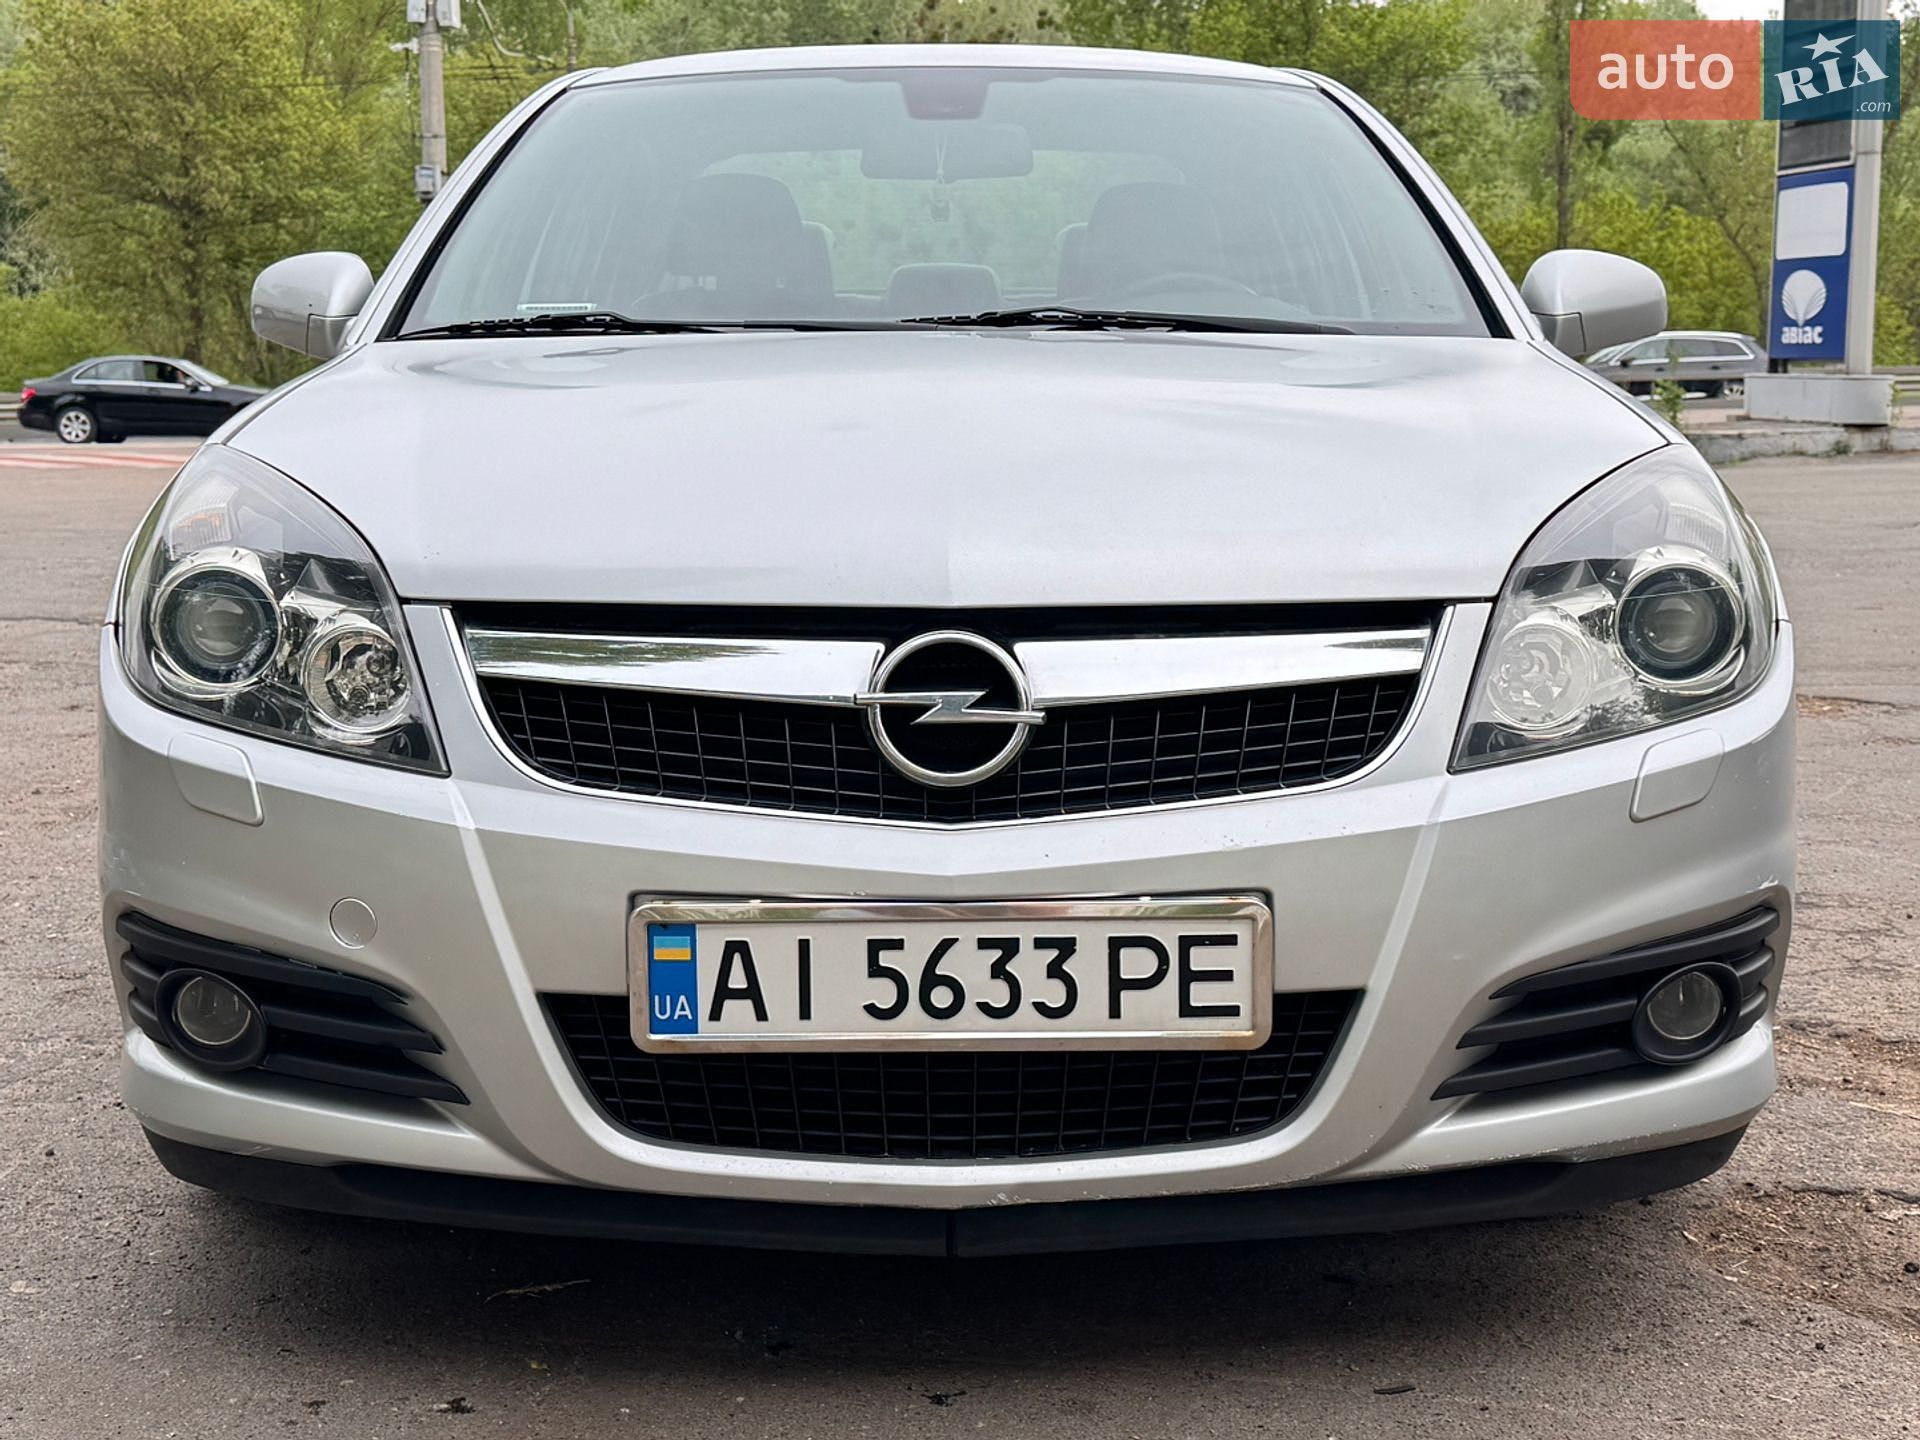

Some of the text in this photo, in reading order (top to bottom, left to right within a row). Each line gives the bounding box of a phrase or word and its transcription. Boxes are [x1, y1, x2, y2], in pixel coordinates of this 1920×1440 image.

[708, 934, 1240, 1022] AI 5633 PE
[653, 994, 693, 1021] UA
